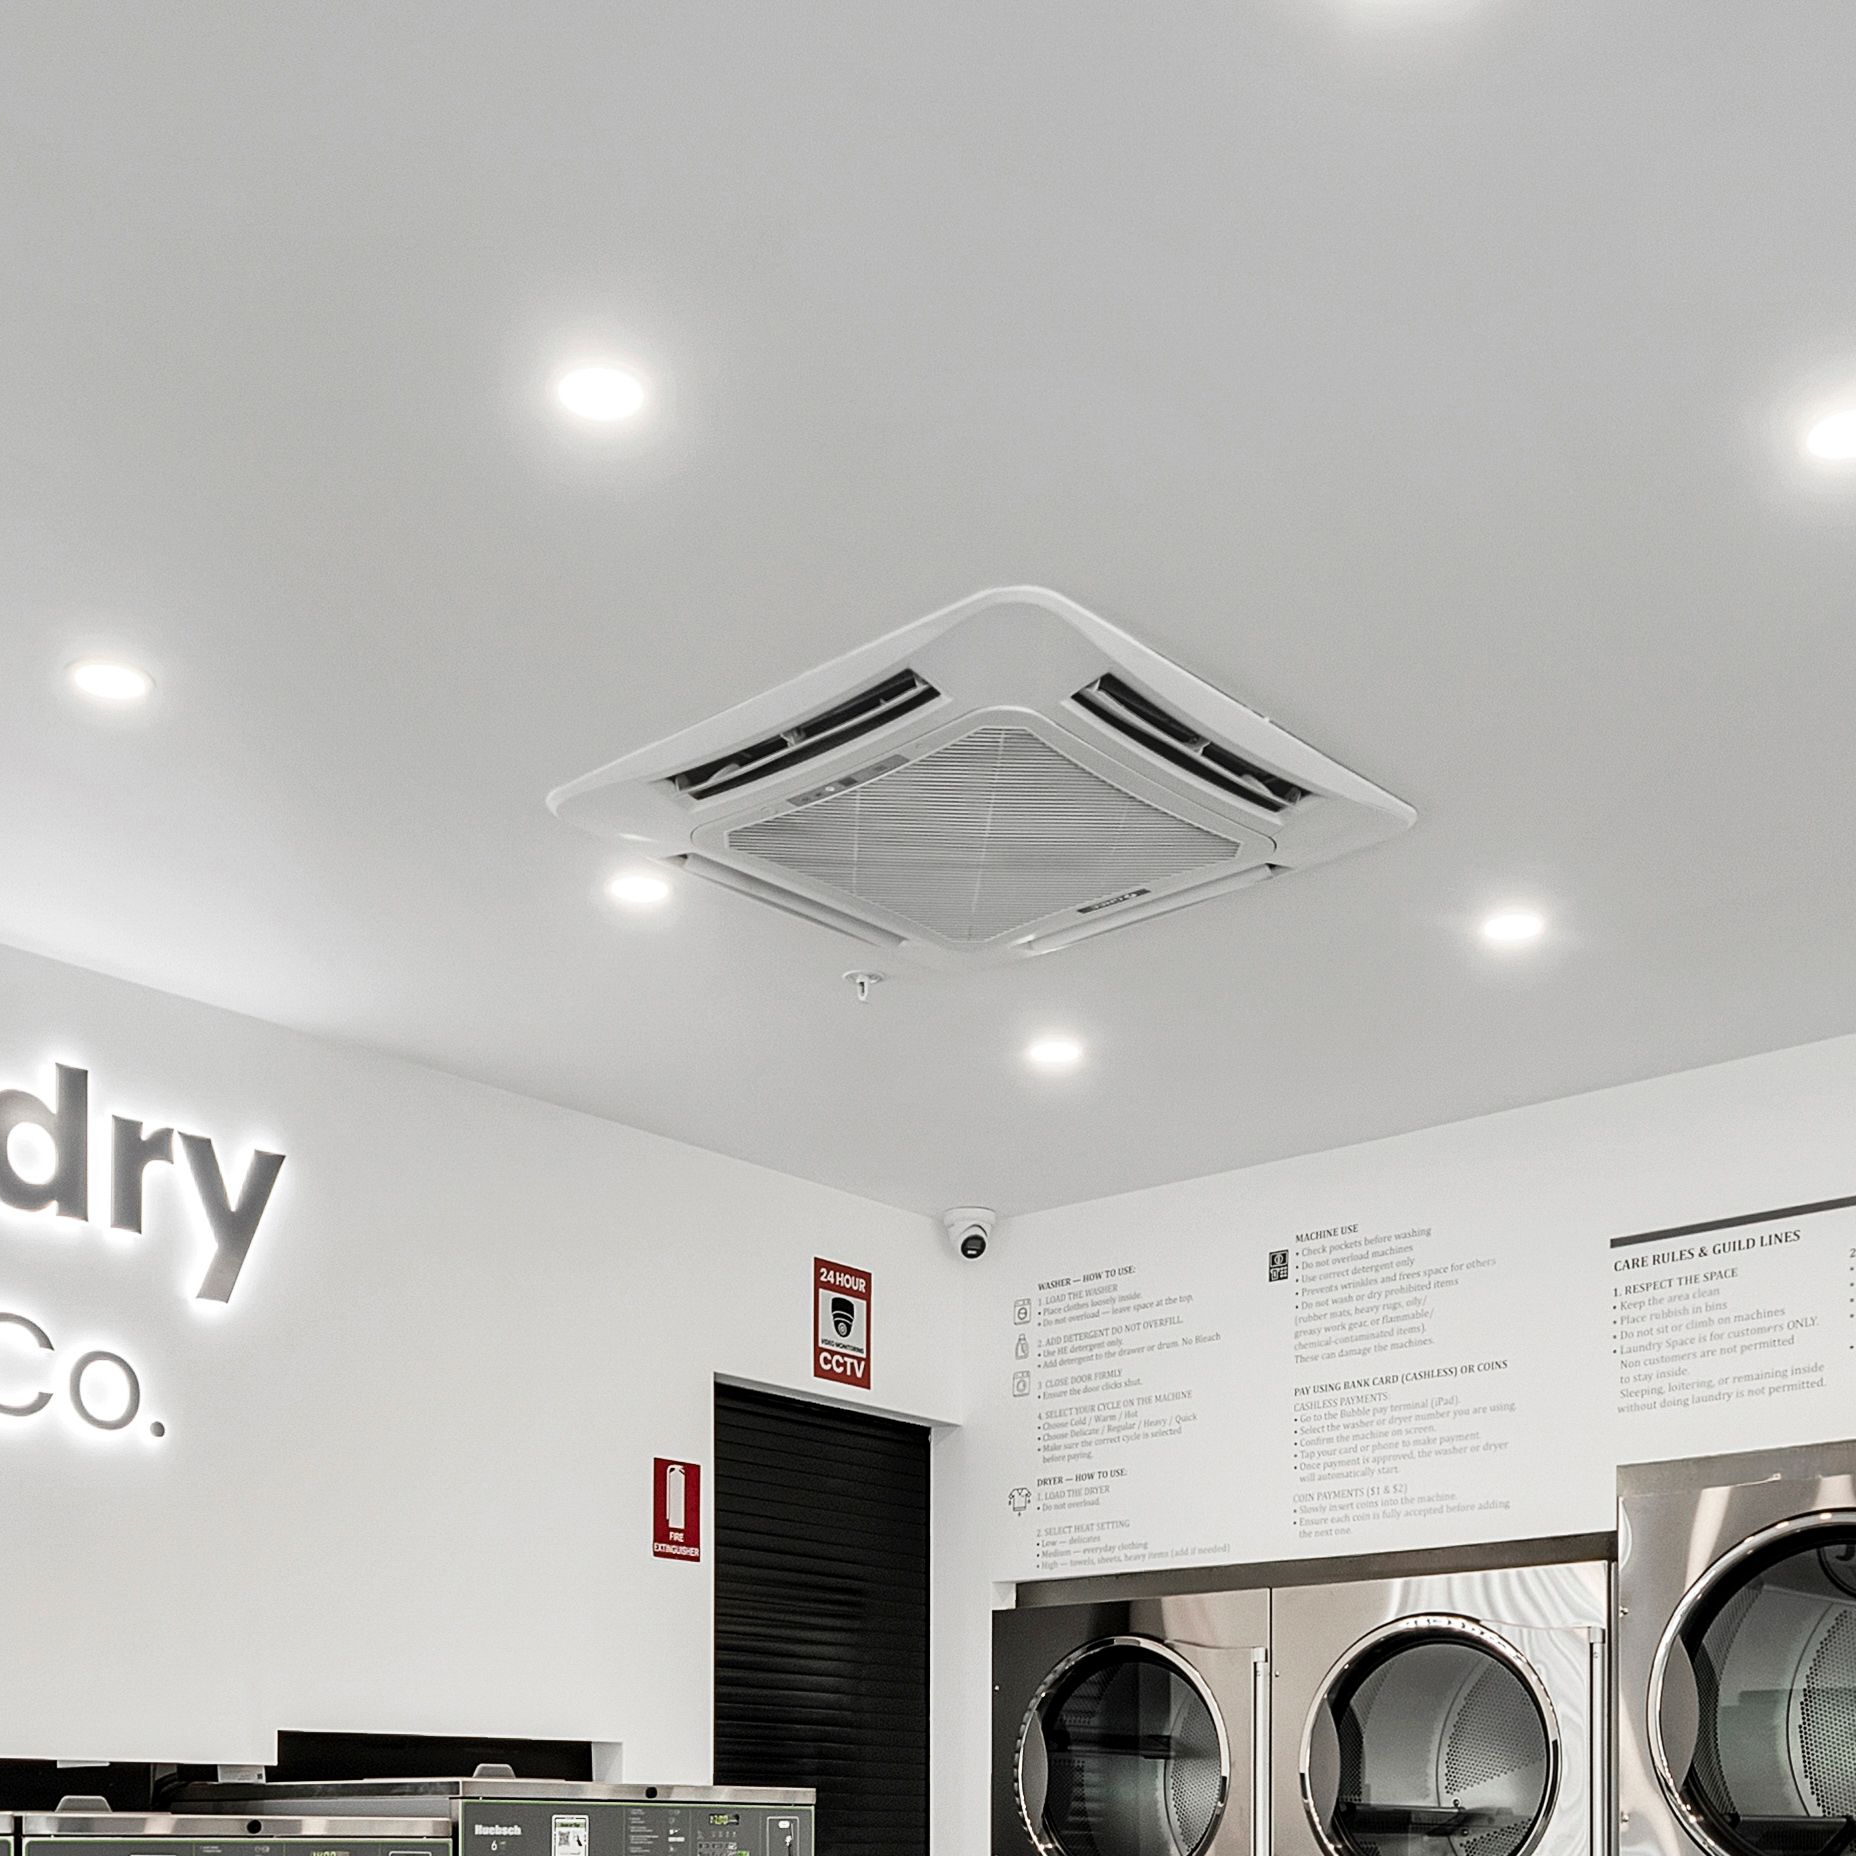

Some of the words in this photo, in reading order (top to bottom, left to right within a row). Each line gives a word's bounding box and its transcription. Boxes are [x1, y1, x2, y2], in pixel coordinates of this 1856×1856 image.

[1295, 1227, 1338, 1242] MACHINE
[1340, 1223, 1358, 1235] USE
[1613, 1255, 1648, 1272] CARE
[1652, 1247, 1694, 1265] RULES
[1698, 1245, 1708, 1257] &
[1712, 1237, 1755, 1255] GUILD
[1759, 1229, 1800, 1247] LINES
[820, 1267, 834, 1284] 24
[835, 1271, 866, 1293] HOUR
[1037, 1277, 1071, 1290] WASHER
[1082, 1271, 1103, 1282] HOW
[1105, 1268, 1116, 1278] TO
[1117, 1265, 1135, 1276] USE:
[1613, 1287, 1621, 1297] 1.
[1624, 1278, 1672, 1295] RESPECT
[1678, 1273, 1699, 1286] THE
[1702, 1267, 1738, 1282] SPACE
[1620, 1300, 1645, 1310] Keep
[1647, 1294, 1664, 1306] the
[1666, 1292, 1690, 1303] area
[1691, 1288, 1720, 1299] clean
[1619, 1314, 1646, 1325] Place
[1649, 1306, 1689, 1320] rubbish
[1691, 1304, 1702, 1314] in
[1704, 1301, 1727, 1312] bins
[1619, 1328, 1634, 1339] Do
[1636, 1326, 1653, 1337] not
[1656, 1324, 1668, 1334] sit
[1670, 1324, 1683, 1332] or
[1684, 1317, 1715, 1330] climb
[1716, 1317, 1731, 1325] on
[1733, 1308, 1785, 1322] machines
[819, 1351, 866, 1378] CCTV
[1294, 1385, 1310, 1396] PAY
[1312, 1382, 1341, 1394] USING
[1343, 1378, 1370, 1390] BANK
[1372, 1374, 1399, 1386] CARD
[1400, 1365, 1458, 1383] (CASHLESS)
[1460, 1364, 1475, 1374] OR
[1476, 1359, 1508, 1372] COINS
[1036, 1476, 1063, 1486] DRYER
[1074, 1472, 1095, 1481] HOW
[1097, 1470, 1108, 1479] TO
[1109, 1467, 1127, 1477] USE:
[669, 1531, 684, 1543] FIRE
[654, 1542, 700, 1557] EXTINGUISHER
[474, 1823, 522, 1836] Huebsch
[490, 1839, 498, 1851] 6
